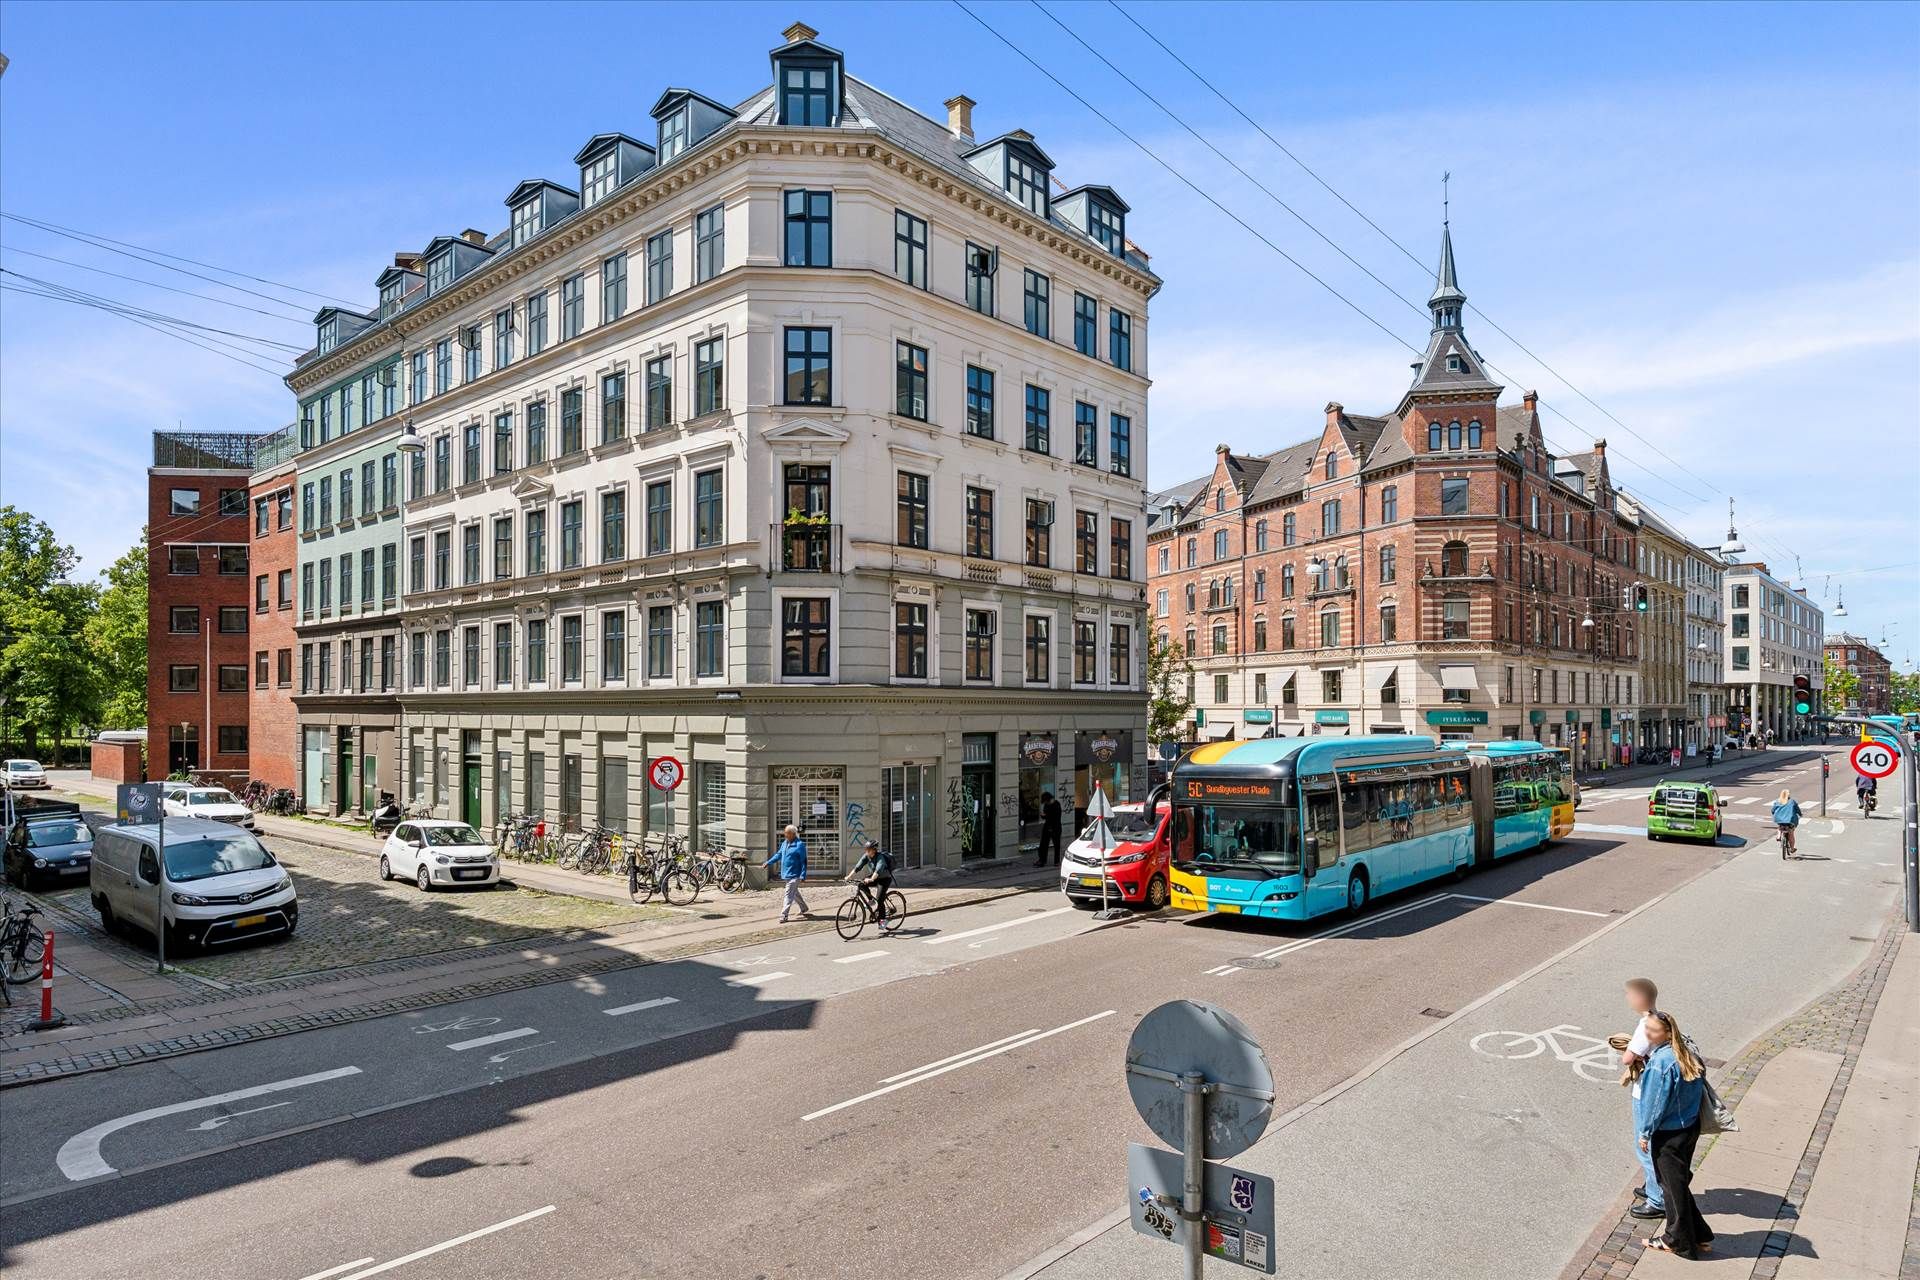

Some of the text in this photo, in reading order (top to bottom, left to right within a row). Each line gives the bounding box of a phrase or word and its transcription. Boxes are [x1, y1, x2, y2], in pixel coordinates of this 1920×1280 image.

[1859, 752, 1888, 767] 40
[1188, 782, 1203, 798] 5C
[1246, 1259, 1265, 1269] ARKEN
